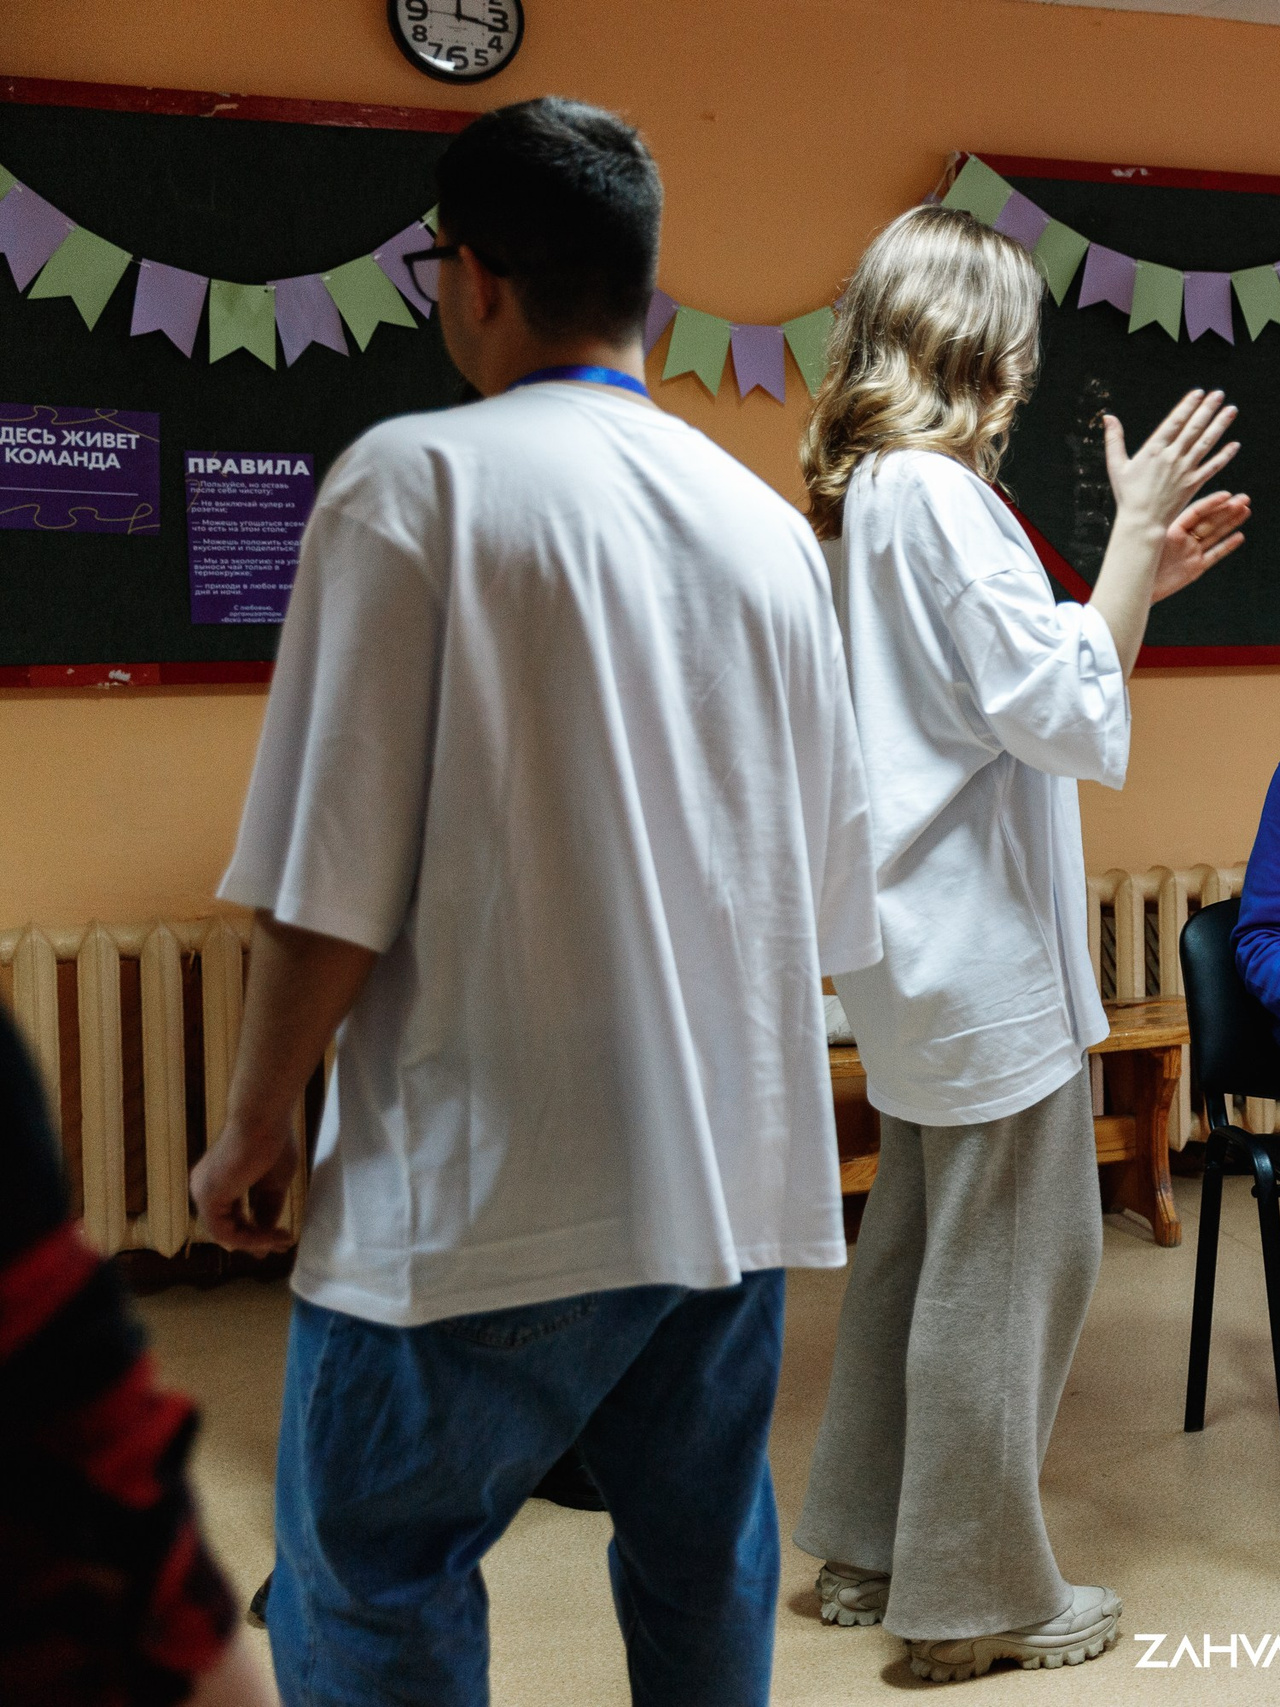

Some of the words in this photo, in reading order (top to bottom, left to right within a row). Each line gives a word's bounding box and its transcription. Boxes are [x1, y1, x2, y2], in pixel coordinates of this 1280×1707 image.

[488, 8, 509, 33] 3
[412, 25, 428, 42] 8
[428, 41, 443, 60] 7
[488, 35, 503, 53] 4
[446, 45, 469, 70] 6
[474, 49, 489, 66] 5
[61, 430, 140, 449] ЖИВЕТ
[5, 447, 121, 470] КОМАНДА
[188, 458, 310, 475] ПРАВИЛА
